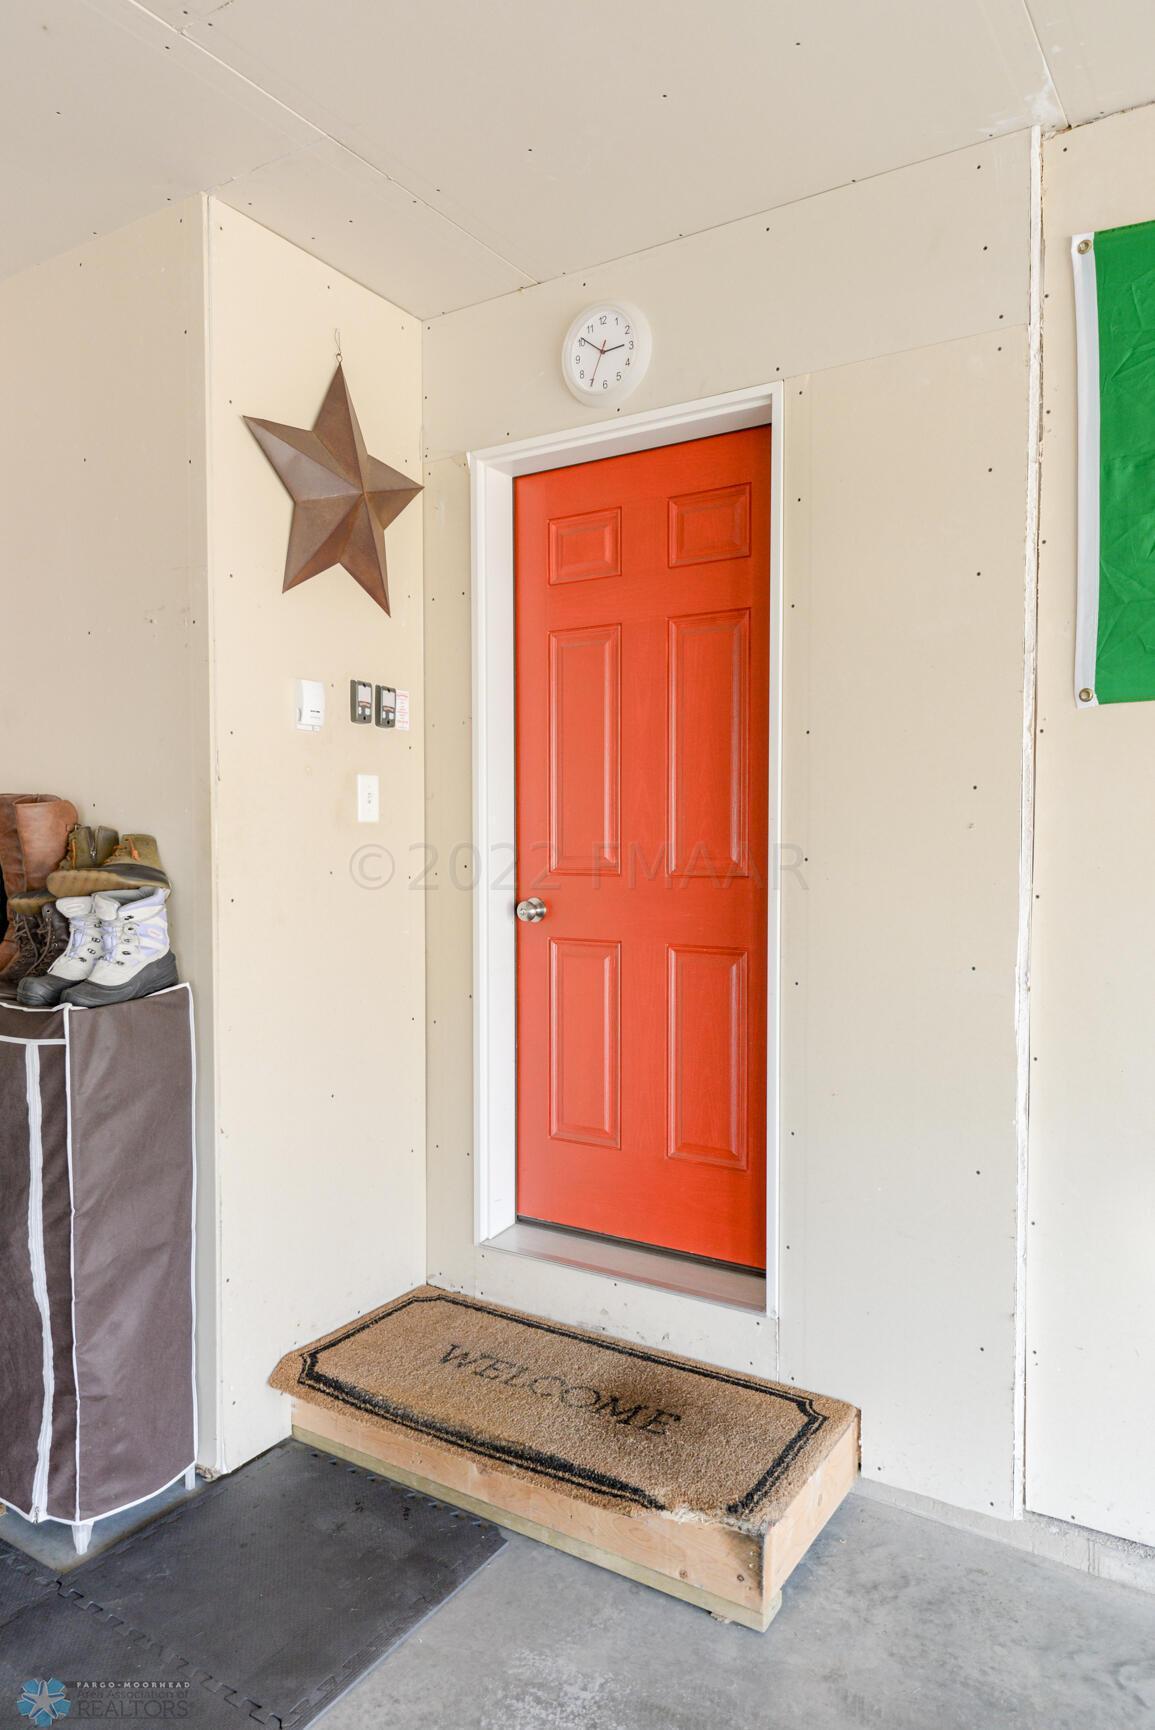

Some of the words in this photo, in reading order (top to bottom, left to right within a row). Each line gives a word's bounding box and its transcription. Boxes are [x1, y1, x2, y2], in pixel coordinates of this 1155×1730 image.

[599, 315, 607, 325] 12
[587, 324, 594, 334] 11
[624, 325, 631, 335] 2
[628, 340, 634, 350] 3
[575, 355, 581, 364] 9
[625, 358, 631, 367] 4
[579, 370, 585, 379] 8
[616, 371, 622, 381] 5
[602, 380, 608, 389] 6
[440, 1343, 682, 1436] WELCOME
